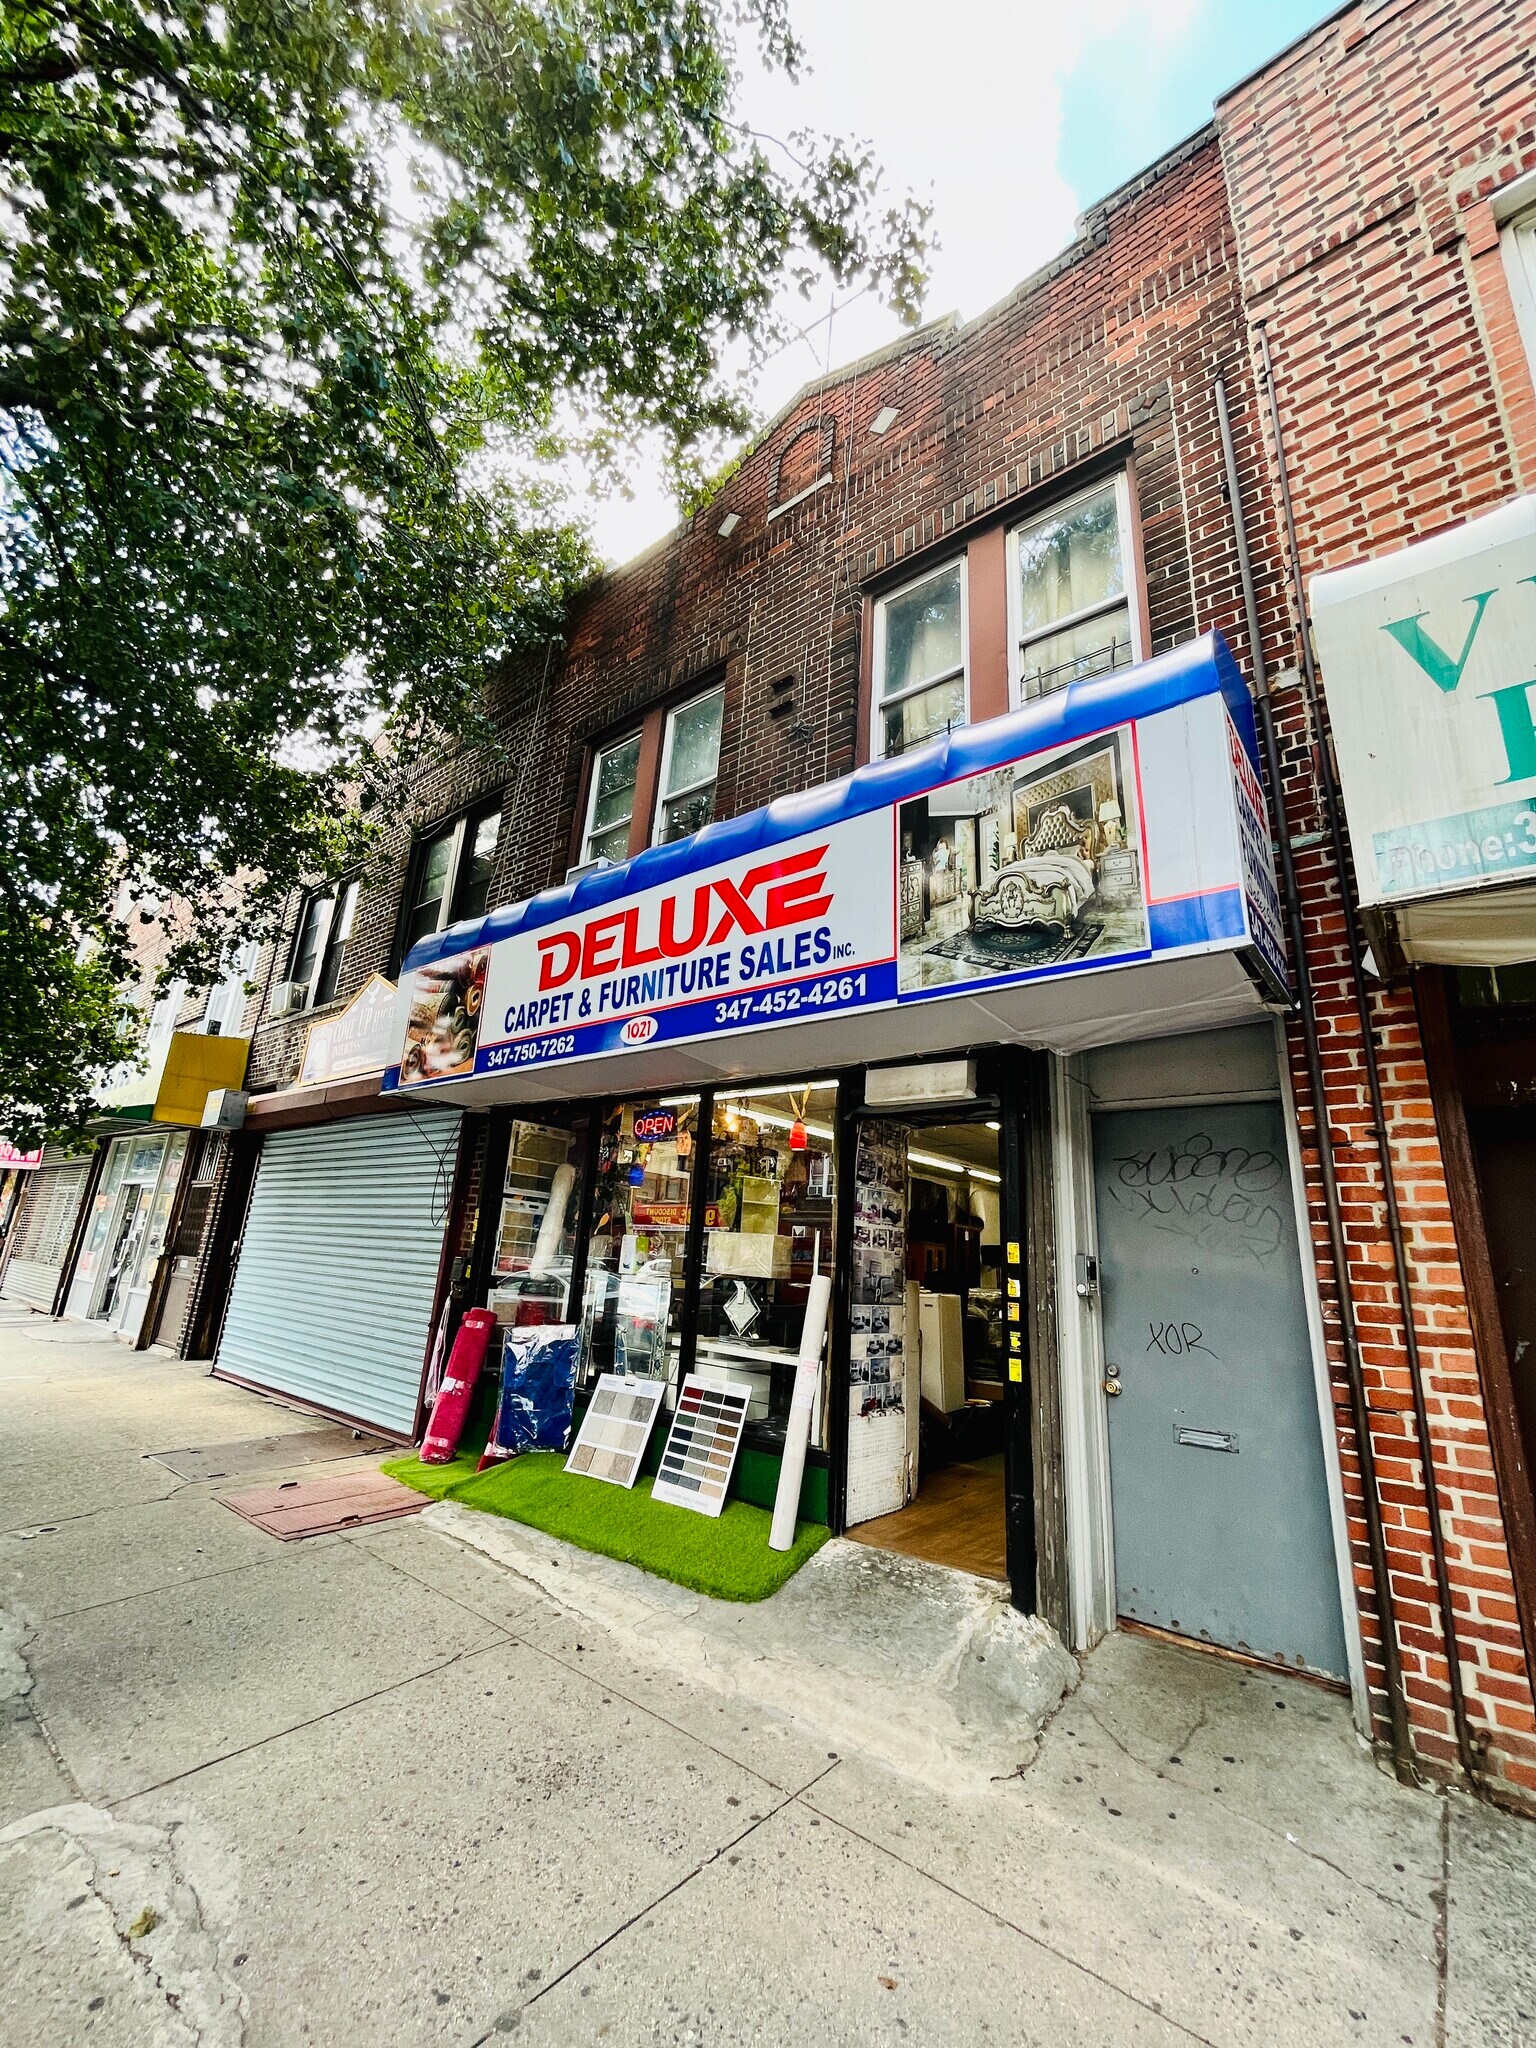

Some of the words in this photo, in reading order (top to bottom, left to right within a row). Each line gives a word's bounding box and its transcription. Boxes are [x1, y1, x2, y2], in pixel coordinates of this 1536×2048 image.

[538, 843, 834, 992] DELUXE
[504, 991, 573, 1034] CARPET
[578, 987, 592, 1018] &
[599, 951, 731, 1013] FURNITURE
[739, 926, 831, 980] SALES
[833, 942, 855, 960] INC.
[715, 973, 867, 1024] 347-452-4261
[627, 1020, 651, 1039] 1021
[487, 1034, 575, 1067] 347-750-7262
[634, 1116, 674, 1136] OPEN
[1146, 1322, 1220, 1360] XOR
